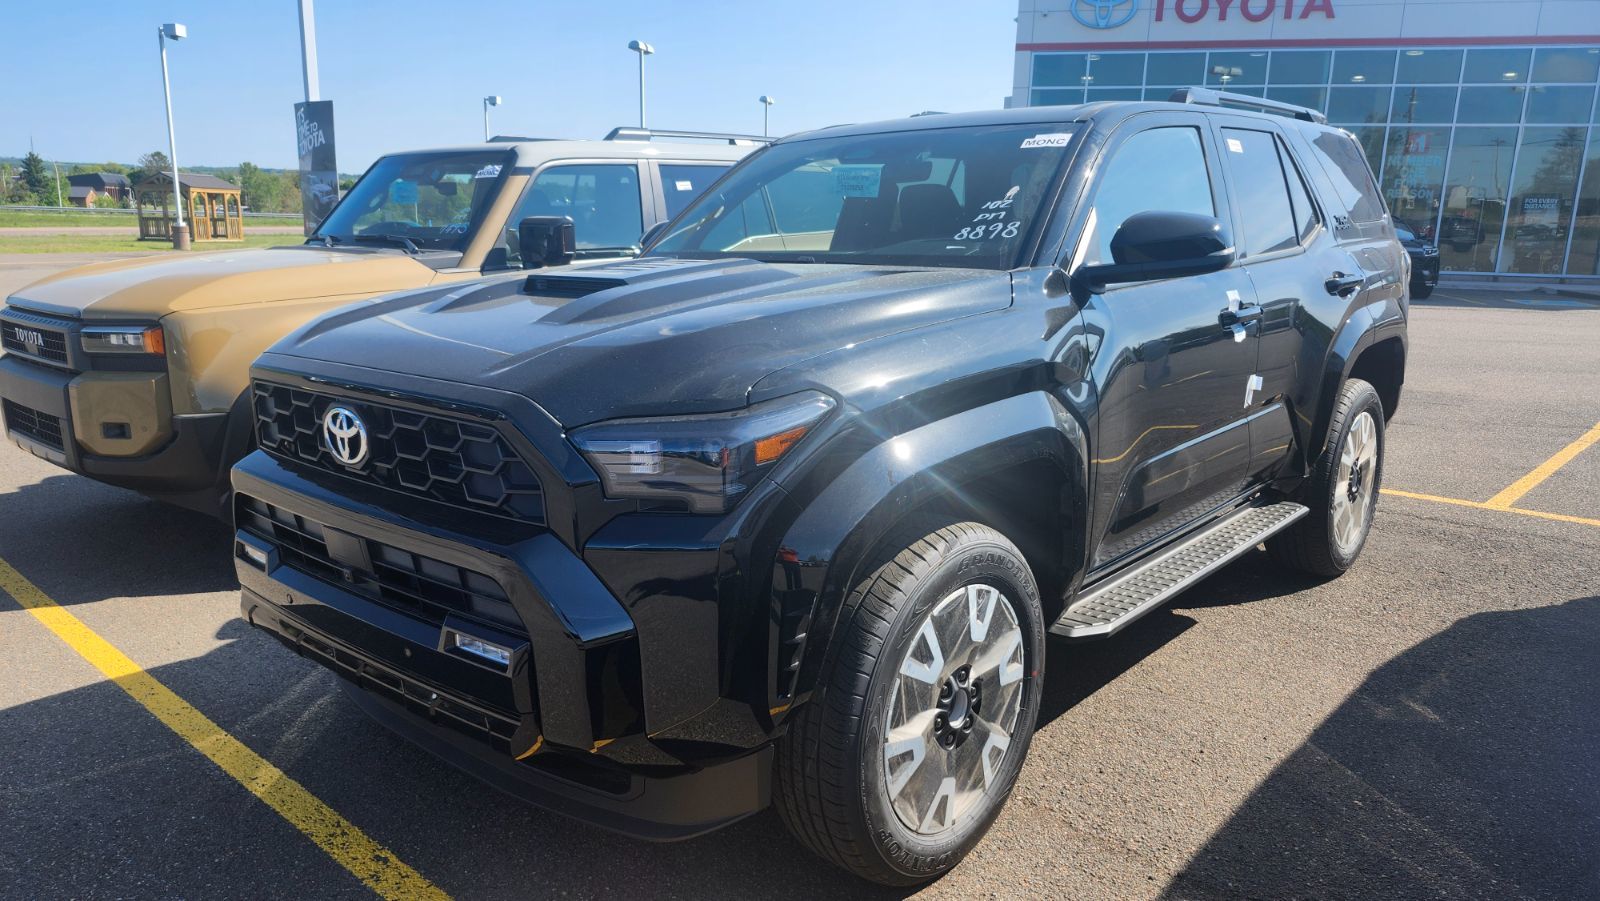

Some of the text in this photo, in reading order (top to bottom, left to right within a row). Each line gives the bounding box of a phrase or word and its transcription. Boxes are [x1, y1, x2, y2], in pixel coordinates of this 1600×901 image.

[310, 121, 318, 134] TO
[1024, 138, 1066, 147] MONC
[953, 221, 1021, 240] 8898
[14, 327, 44, 347] TOYOTA
